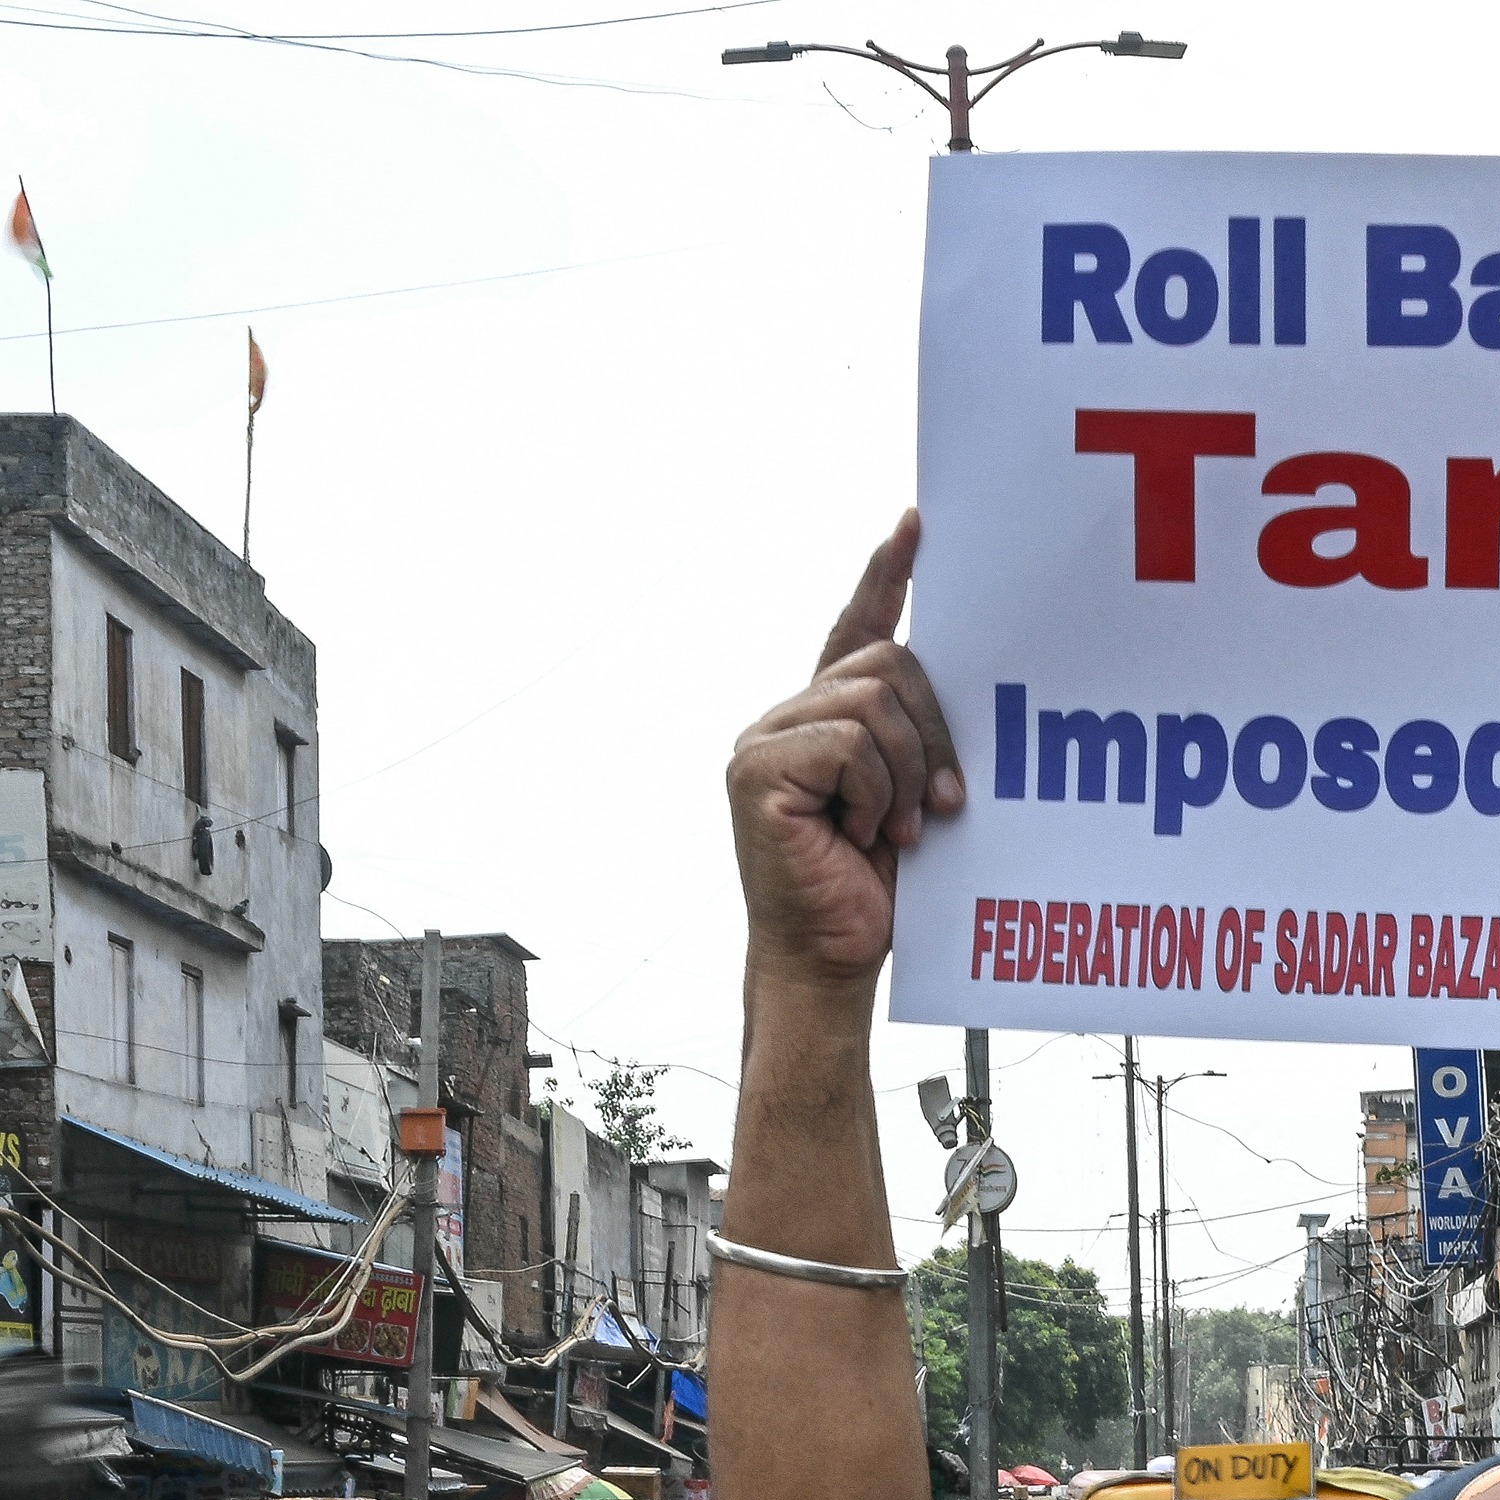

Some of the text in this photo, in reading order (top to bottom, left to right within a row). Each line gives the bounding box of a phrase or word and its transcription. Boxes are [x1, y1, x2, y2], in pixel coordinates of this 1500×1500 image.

[1041, 217, 1307, 346] Roll
[972, 899, 1204, 988] FEDERATION
[1216, 909, 1265, 991] OF
[1275, 911, 1398, 996] SADAR
[1184, 1452, 1300, 1486] ON DUTY
